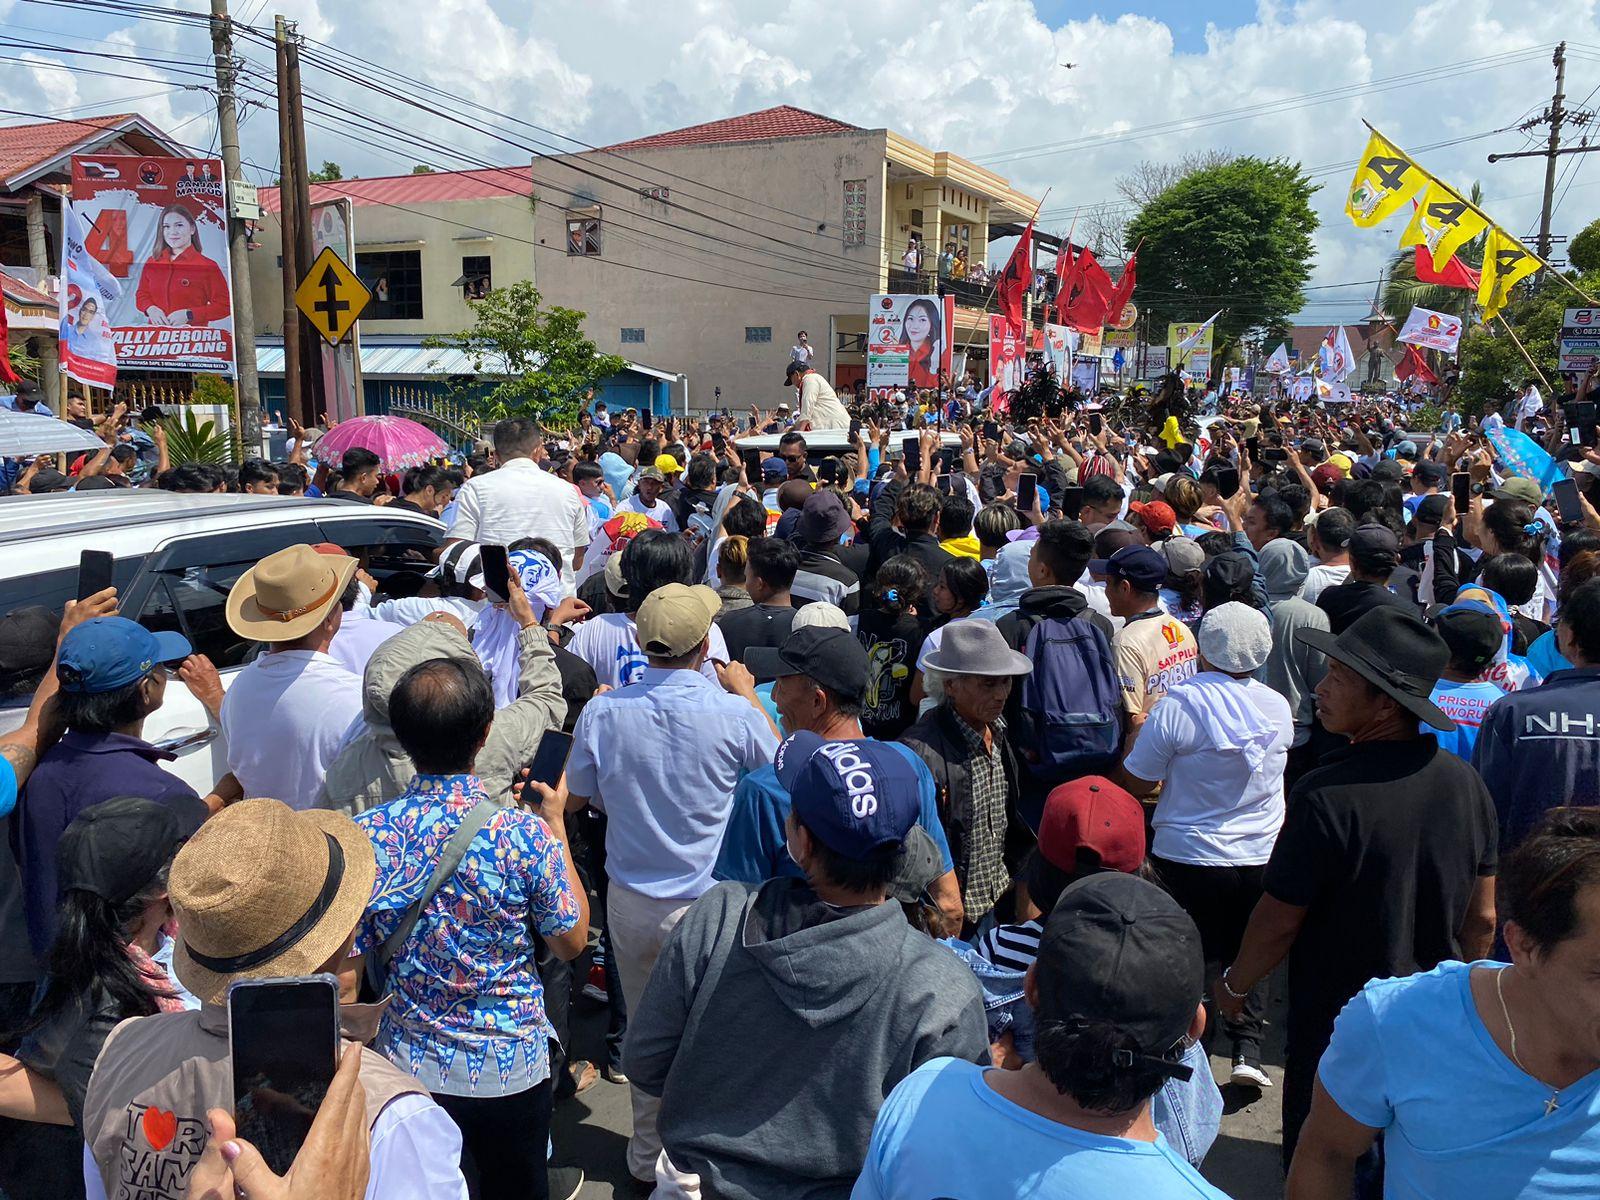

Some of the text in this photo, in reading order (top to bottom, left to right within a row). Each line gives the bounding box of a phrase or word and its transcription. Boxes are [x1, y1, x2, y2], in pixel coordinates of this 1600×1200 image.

[176, 181, 221, 189] GANJAR
[176, 188, 222, 197] MAHFUD
[84, 209, 134, 278] 4
[158, 330, 222, 343] DEBORA
[882, 329, 891, 342] 2
[1446, 323, 1459, 337] 2
[118, 341, 227, 358] SUMOLANG
[1525, 711, 1600, 735] NH
